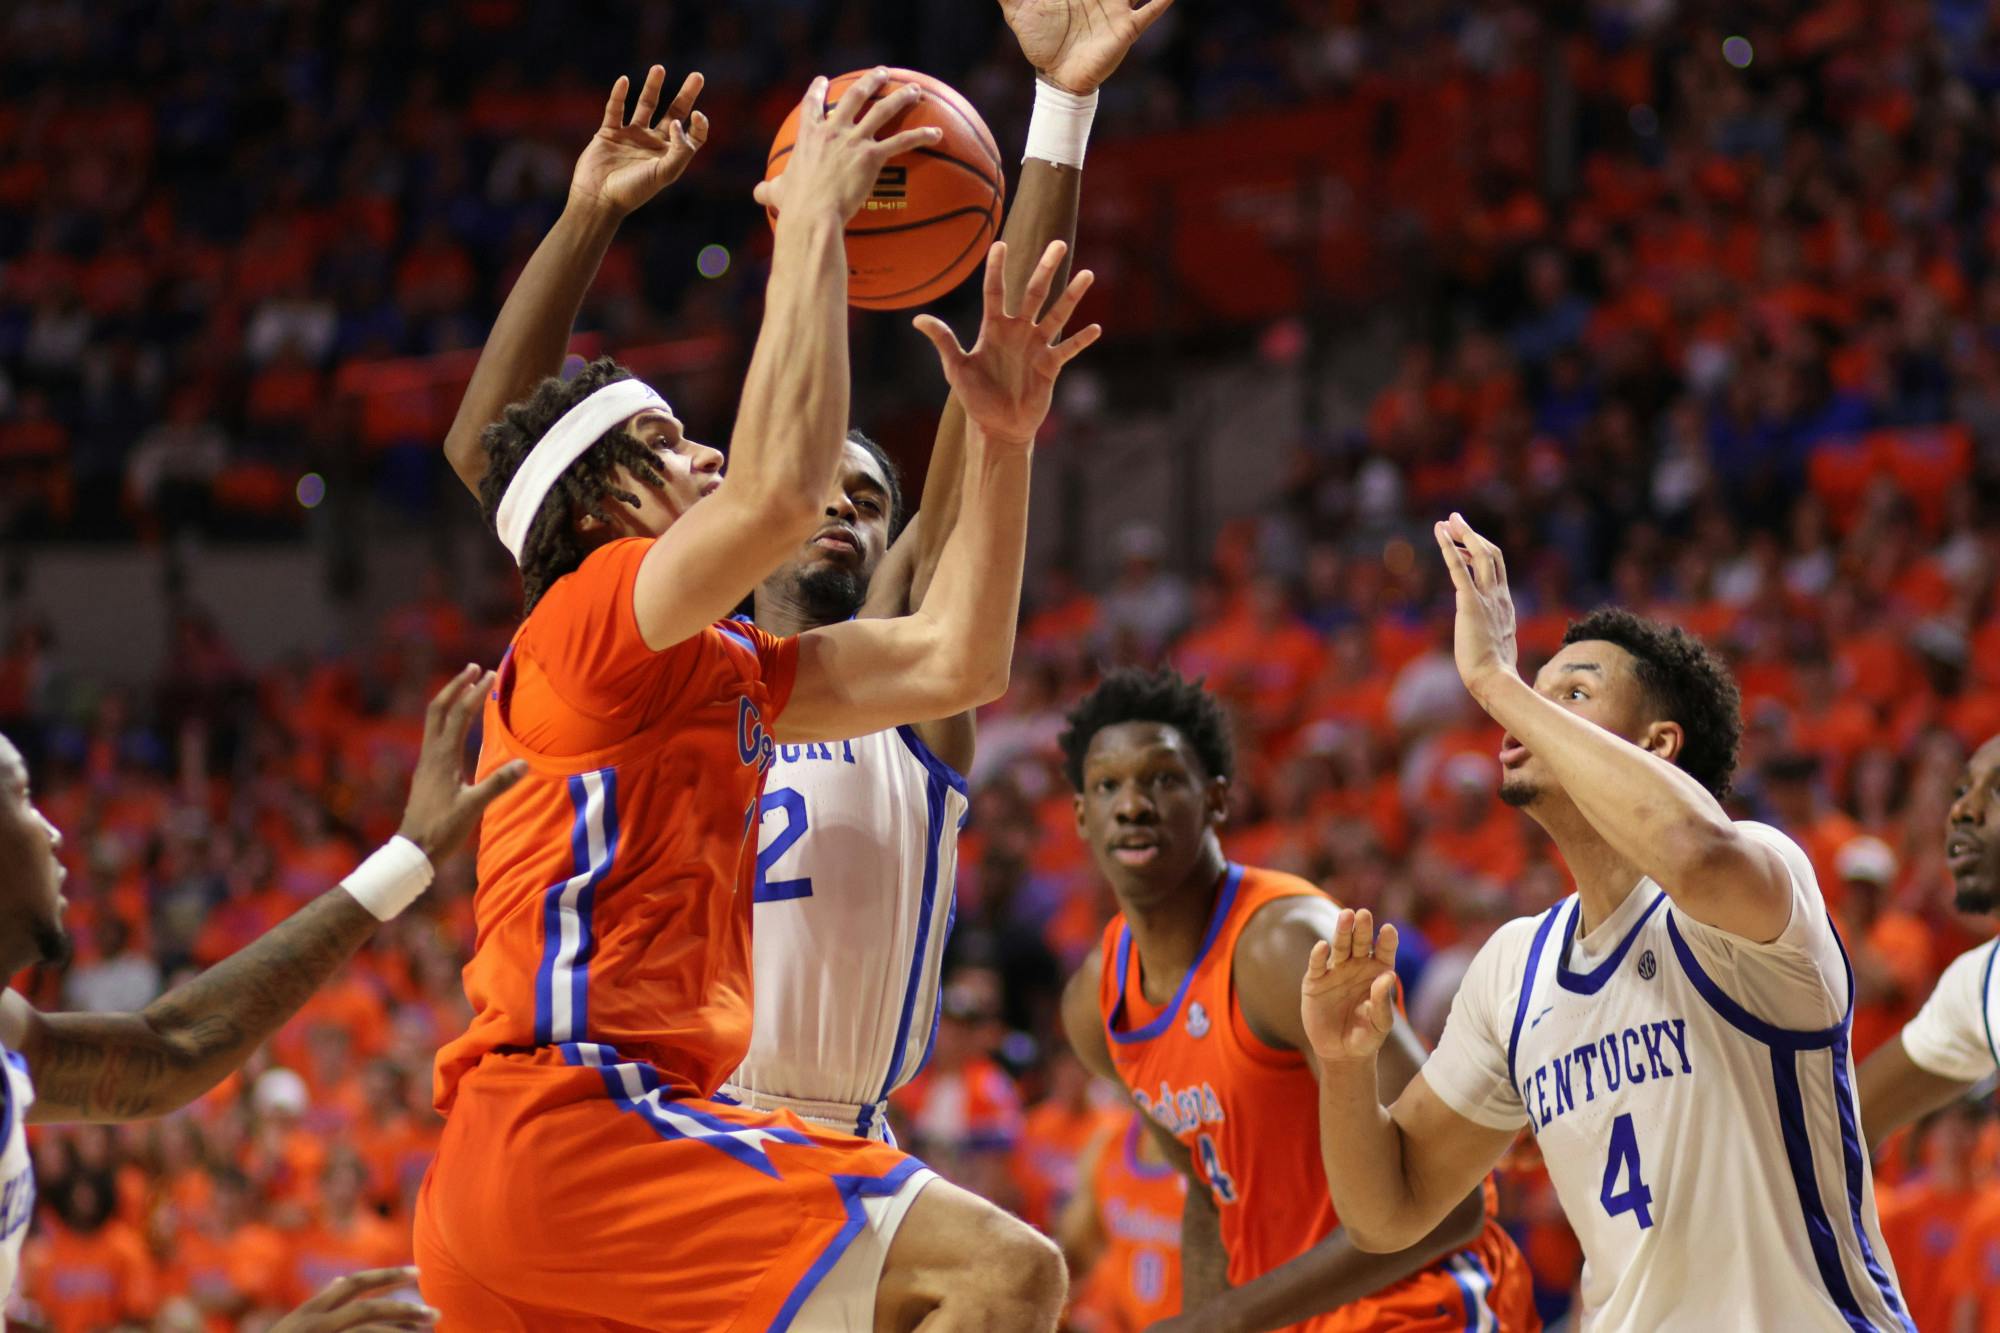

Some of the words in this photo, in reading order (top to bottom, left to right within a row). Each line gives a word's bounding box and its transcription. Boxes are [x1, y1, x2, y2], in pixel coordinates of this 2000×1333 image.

[864, 201, 907, 210] SHIP
[1639, 951, 1655, 978] SEC
[1523, 1018, 1692, 1135] KENTUCKY
[1600, 1112, 1653, 1229] 4
